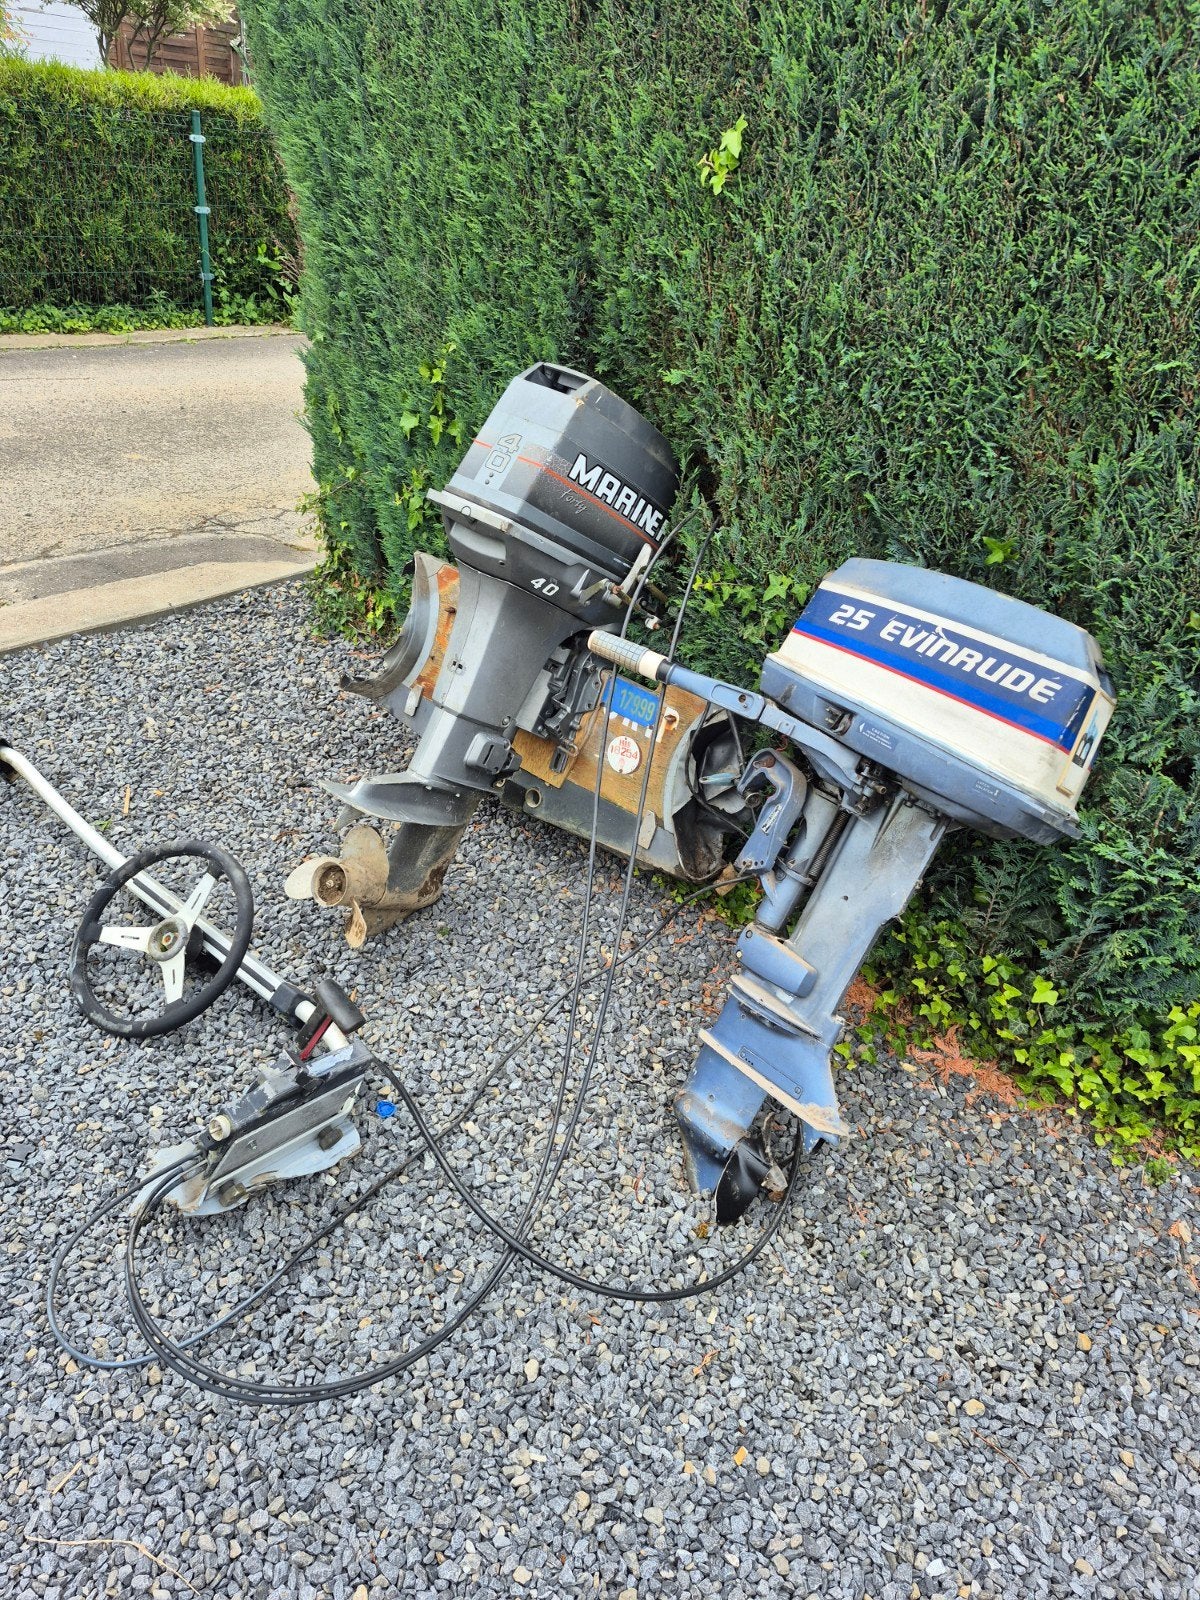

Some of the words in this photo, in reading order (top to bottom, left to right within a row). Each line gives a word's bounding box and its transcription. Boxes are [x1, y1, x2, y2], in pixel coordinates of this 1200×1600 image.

[485, 433, 523, 474] 40
[530, 576, 560, 597] 40
[829, 604, 876, 632] 25
[619, 688, 656, 722] 17999
